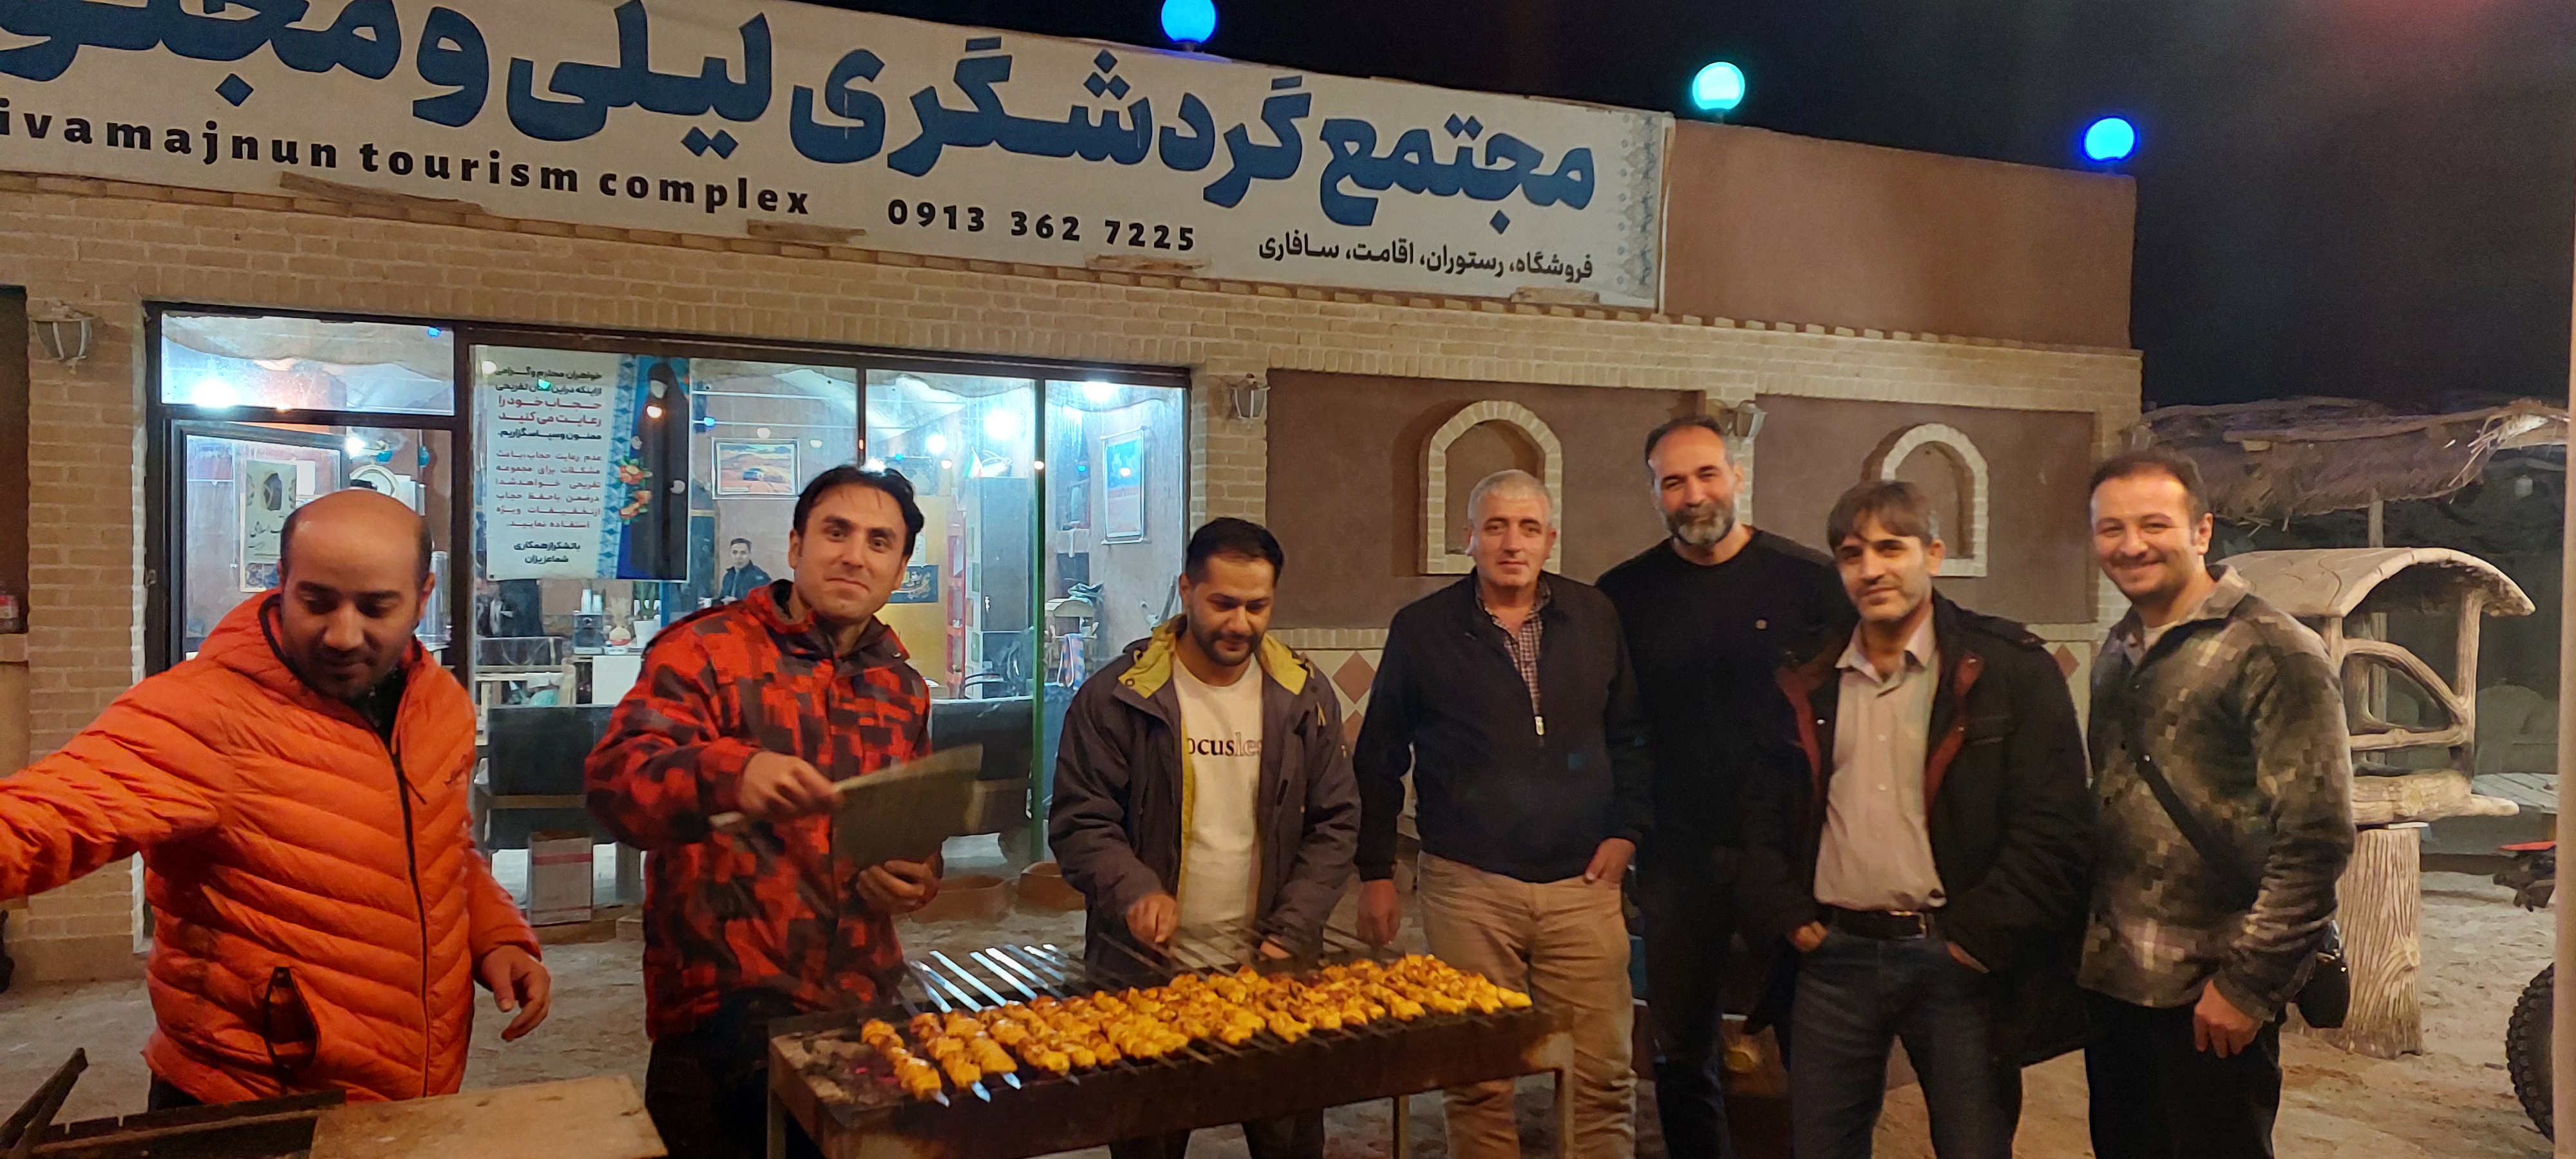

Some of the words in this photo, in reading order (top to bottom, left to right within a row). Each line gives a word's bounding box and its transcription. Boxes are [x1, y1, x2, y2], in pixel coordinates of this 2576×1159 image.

[413, 6, 489, 127] و
[506, 0, 772, 160] لیلی
[789, 36, 1312, 209] گردشگری
[359, 144, 578, 193] tourism
[599, 173, 808, 215] complex
[1320, 114, 1595, 234] مجتمع
[888, 199, 984, 232] 0913
[1010, 211, 1080, 241] 362
[1104, 220, 1193, 252] 7225
[1259, 229, 1340, 262] سافاری
[1346, 238, 1414, 266] اقامت،
[1419, 245, 1504, 278] رستوران،
[1510, 251, 1593, 283] فروشگاه،
[498, 394, 506, 408] را
[507, 396, 544, 408] خود
[545, 397, 602, 411] حجاب
[556, 414, 601, 427] رعایت
[495, 465, 532, 474] مجموعه
[554, 452, 580, 462] رعایت
[583, 454, 602, 463] عدم
[496, 491, 522, 501] حجاب
[496, 505, 521, 515] ویژه
